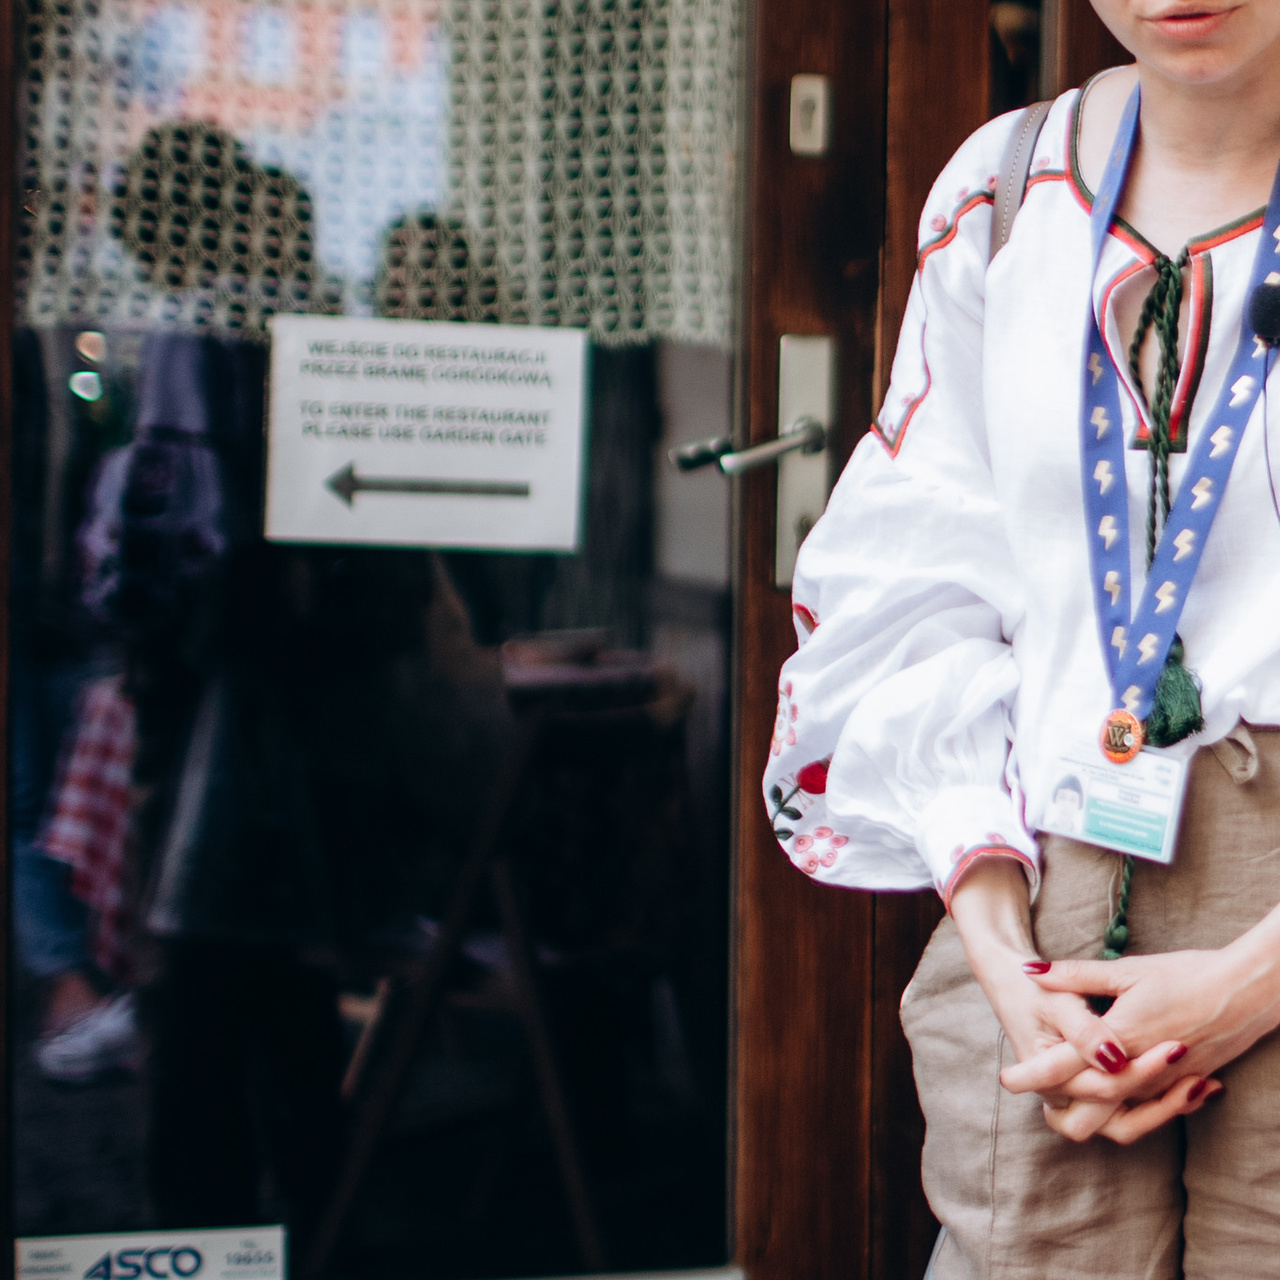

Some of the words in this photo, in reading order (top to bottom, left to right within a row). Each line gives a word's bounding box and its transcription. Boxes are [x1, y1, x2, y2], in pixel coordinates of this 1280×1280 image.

[392, 343, 421, 360] DO
[300, 400, 324, 418] TO
[328, 401, 389, 420] ENTER
[394, 404, 430, 421] THE
[433, 406, 551, 426] RESTAURANT
[302, 422, 375, 441] PLEASE
[378, 424, 416, 441] USE
[419, 426, 495, 447] GARDEN
[499, 429, 547, 448] GATE
